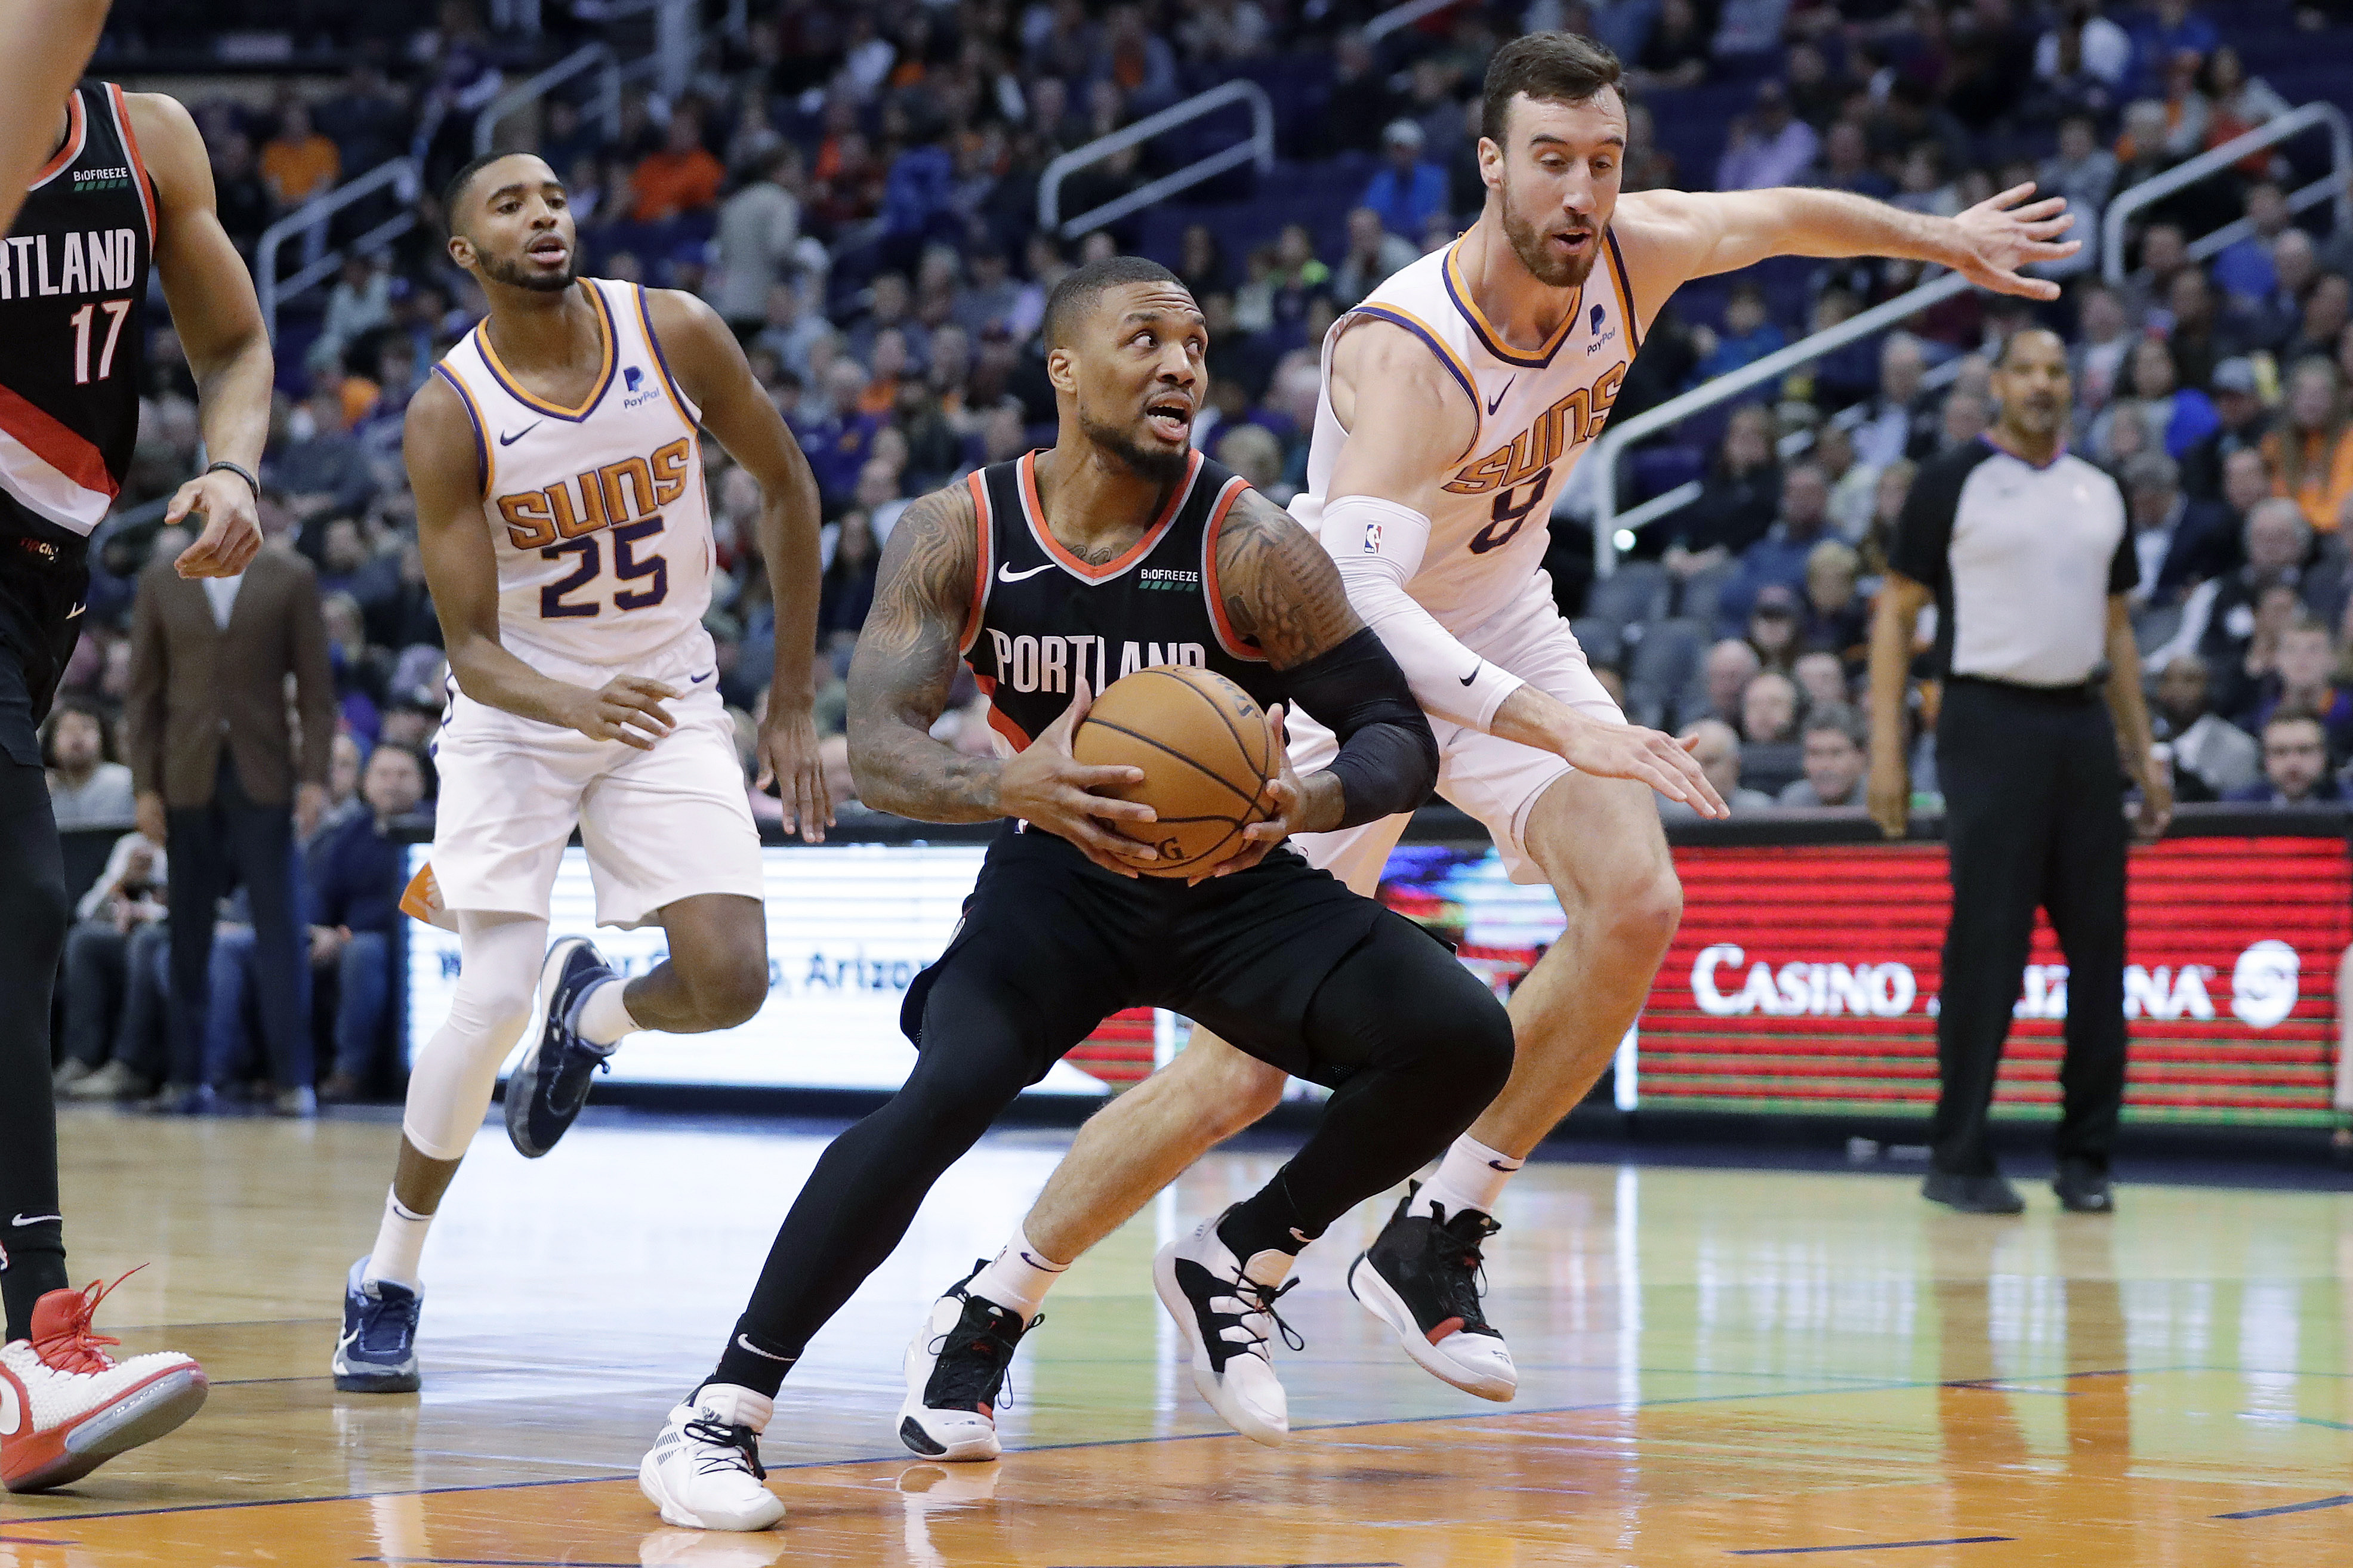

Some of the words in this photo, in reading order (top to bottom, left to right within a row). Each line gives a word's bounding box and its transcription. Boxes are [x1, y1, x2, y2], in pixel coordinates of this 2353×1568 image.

[70, 299, 132, 385] 17
[1587, 326, 1615, 357] PayPal
[624, 387, 660, 409] PayPal
[1440, 360, 1626, 495] SUNS
[497, 437, 689, 550] SUNS
[1467, 466, 1553, 555] 8
[539, 514, 669, 619] 25
